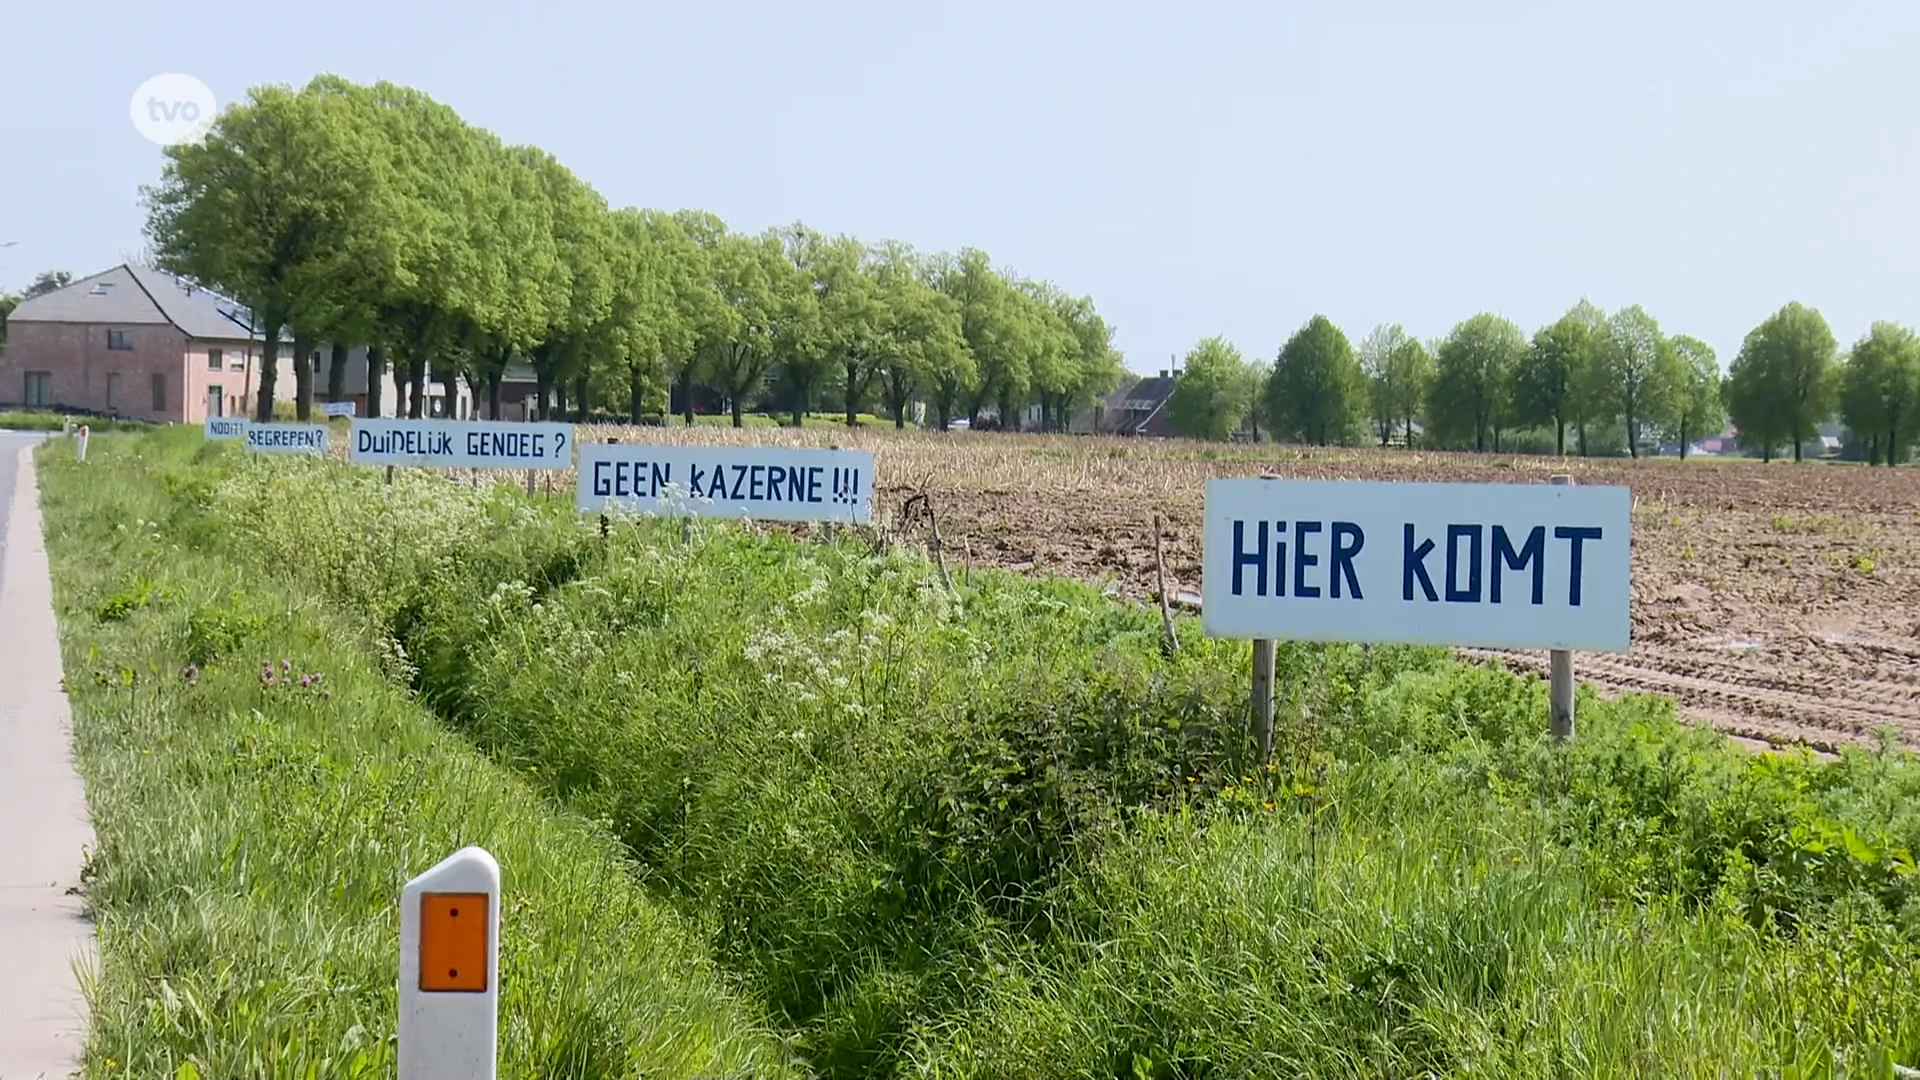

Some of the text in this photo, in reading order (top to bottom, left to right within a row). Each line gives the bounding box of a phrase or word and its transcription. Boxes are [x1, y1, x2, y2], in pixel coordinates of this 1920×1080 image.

[467, 432, 544, 457] GENOEG
[593, 461, 671, 497] GEEN
[1231, 520, 1602, 606] HiER kOMT
